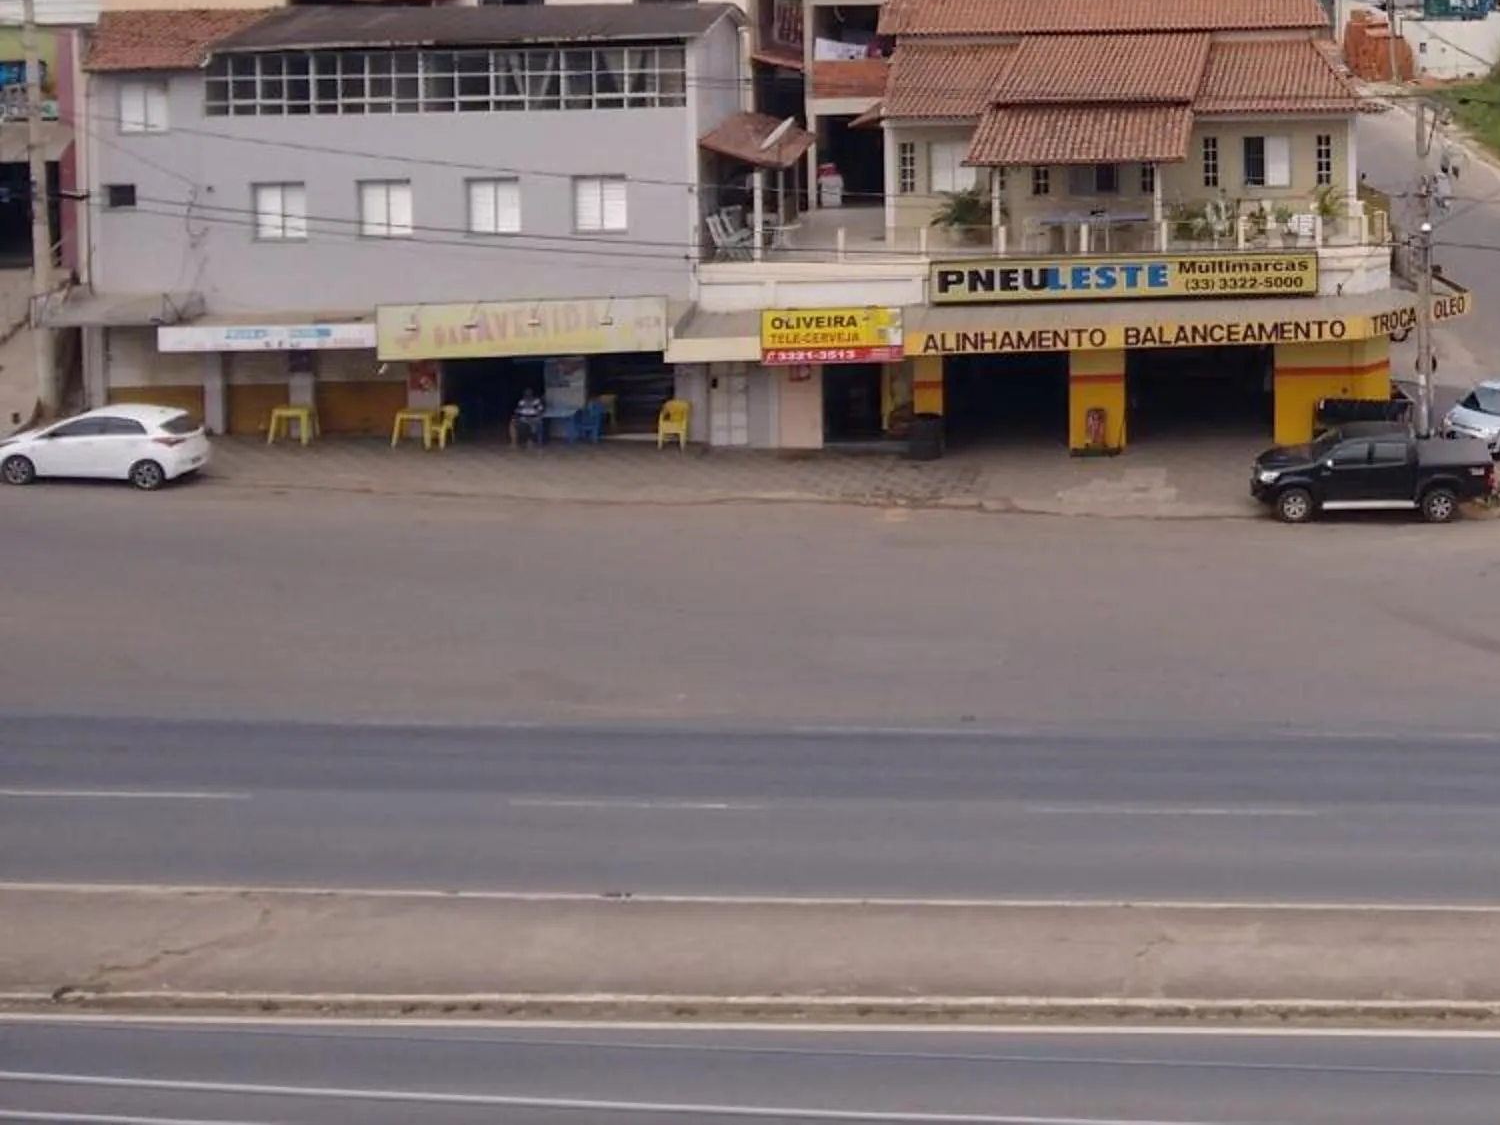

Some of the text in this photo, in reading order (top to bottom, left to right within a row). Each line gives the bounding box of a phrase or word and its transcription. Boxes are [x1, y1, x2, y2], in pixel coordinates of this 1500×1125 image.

[1178, 259, 1309, 275] Multimarcas
[1184, 275, 1304, 293] (33) 3322-5000
[771, 315, 858, 329] OLIVEIRA
[923, 297, 1466, 354] ALINHAMENTO BALANCEAMENTO TROCA OLEO
